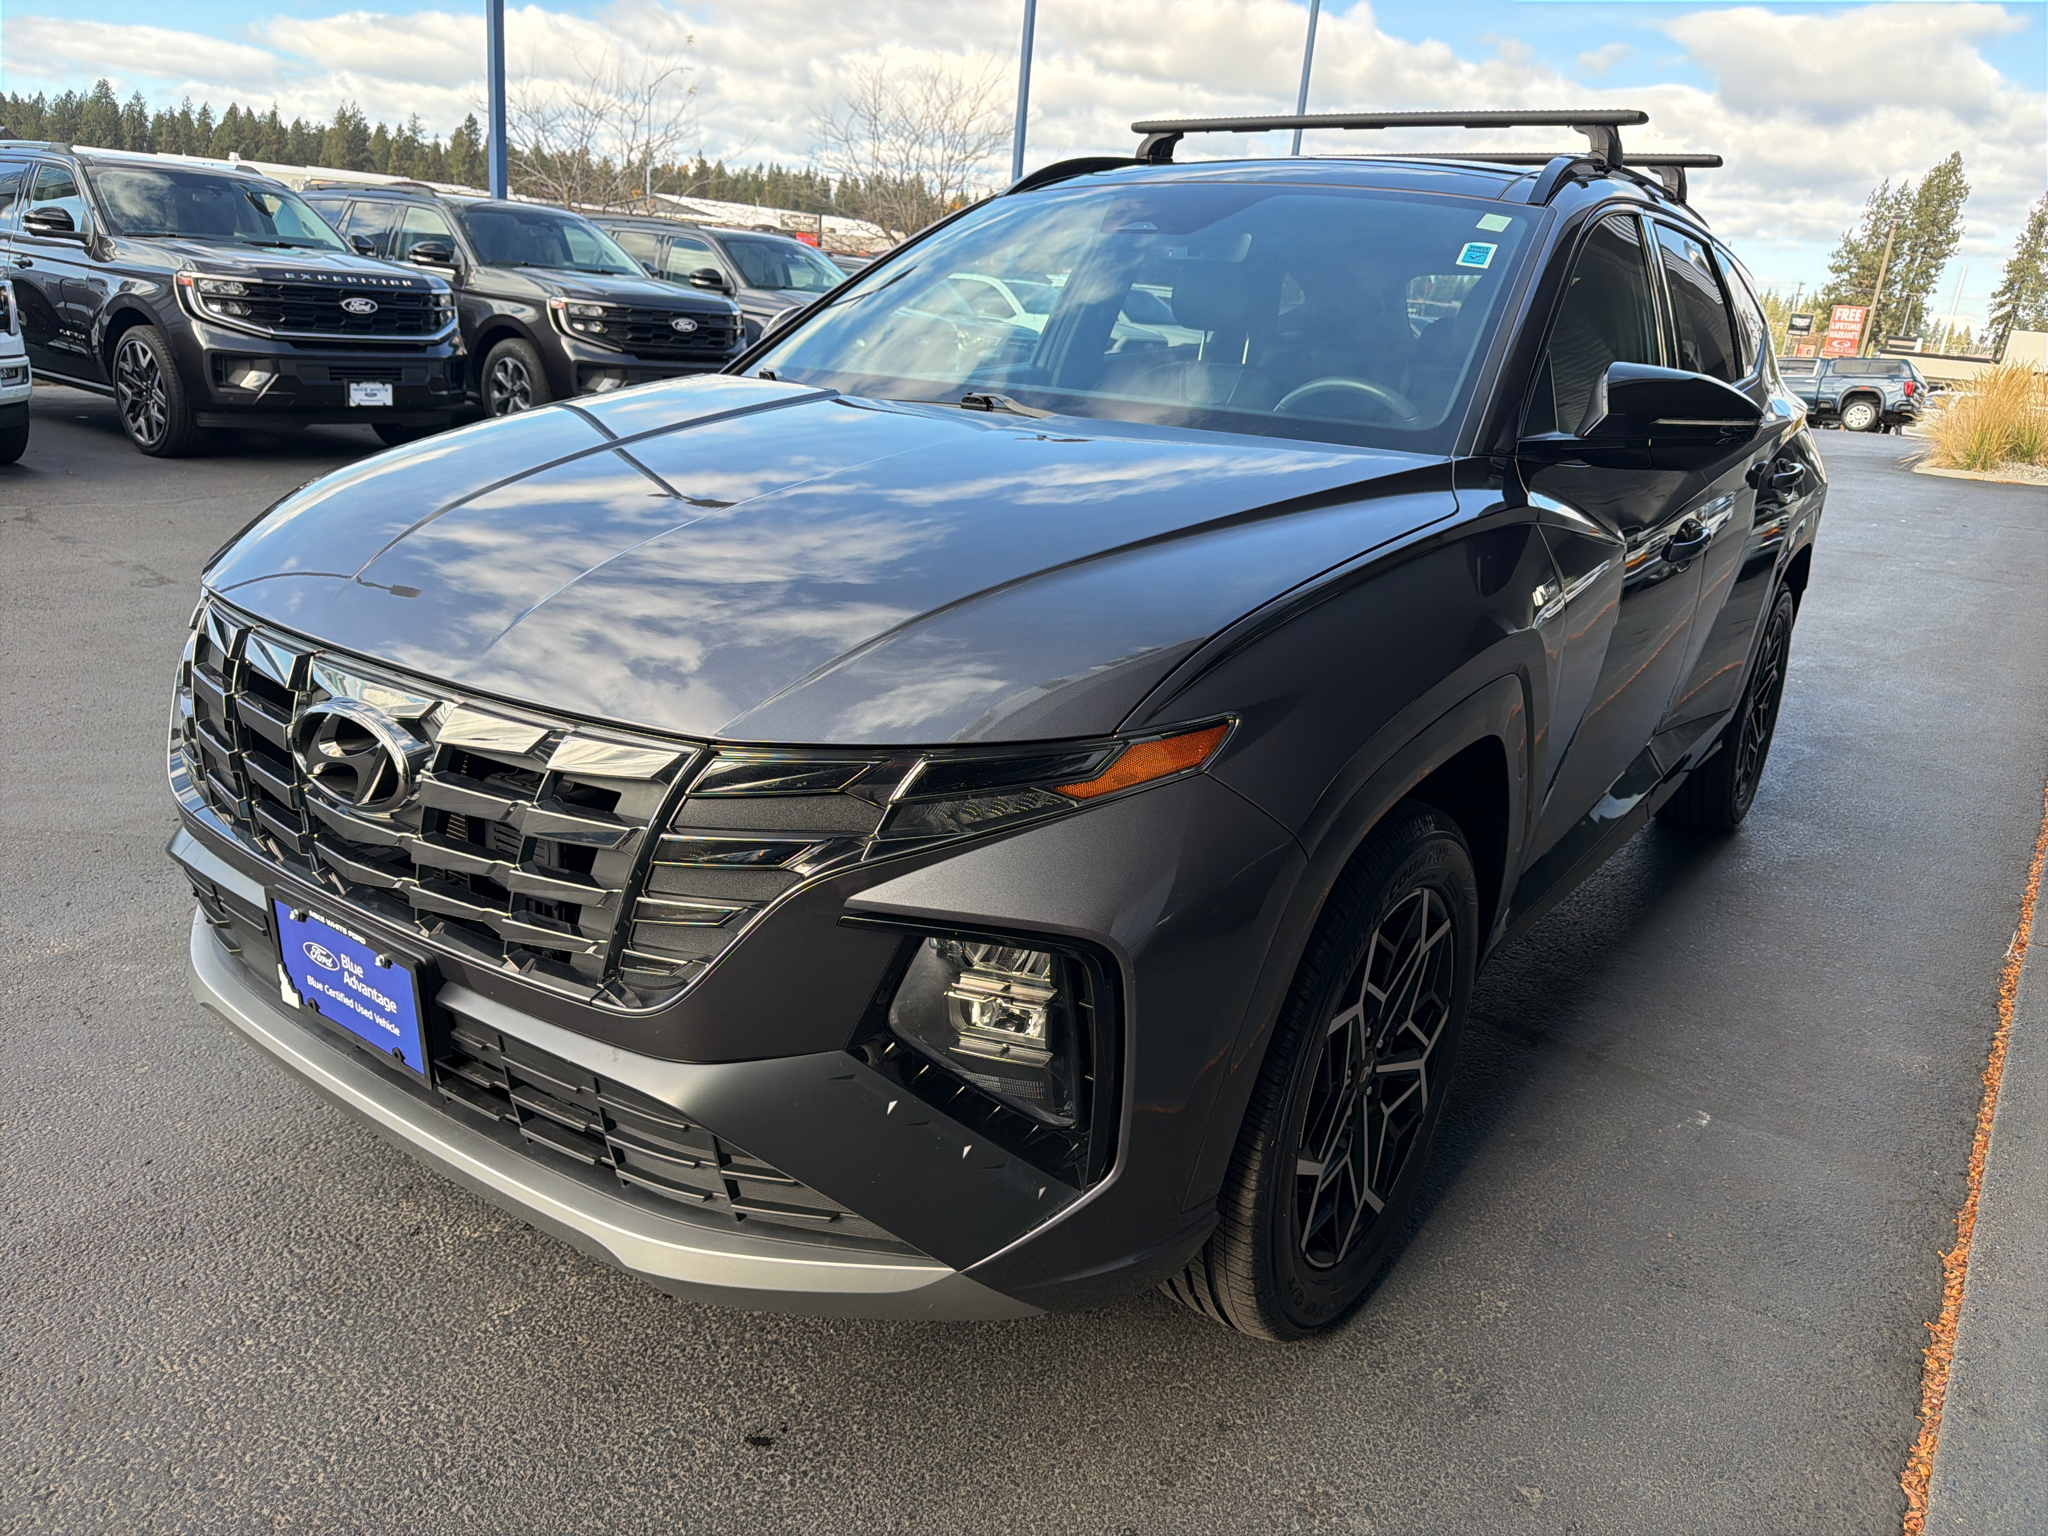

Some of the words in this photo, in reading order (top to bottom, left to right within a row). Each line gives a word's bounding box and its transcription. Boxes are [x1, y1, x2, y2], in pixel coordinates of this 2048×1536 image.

[284, 272, 412, 287] EXPEDITION
[1831, 321, 1862, 331] LIFETIME
[1834, 308, 1863, 321] FREE
[309, 909, 326, 924] MIKE
[325, 918, 348, 936] WHITE
[347, 929, 367, 945] FORD
[340, 953, 364, 979] Blue
[343, 970, 398, 1014] Advantage
[306, 974, 324, 992] Blue
[324, 984, 355, 1009] Certified
[355, 1000, 374, 1021] Used
[374, 1014, 401, 1037] Vehicle
